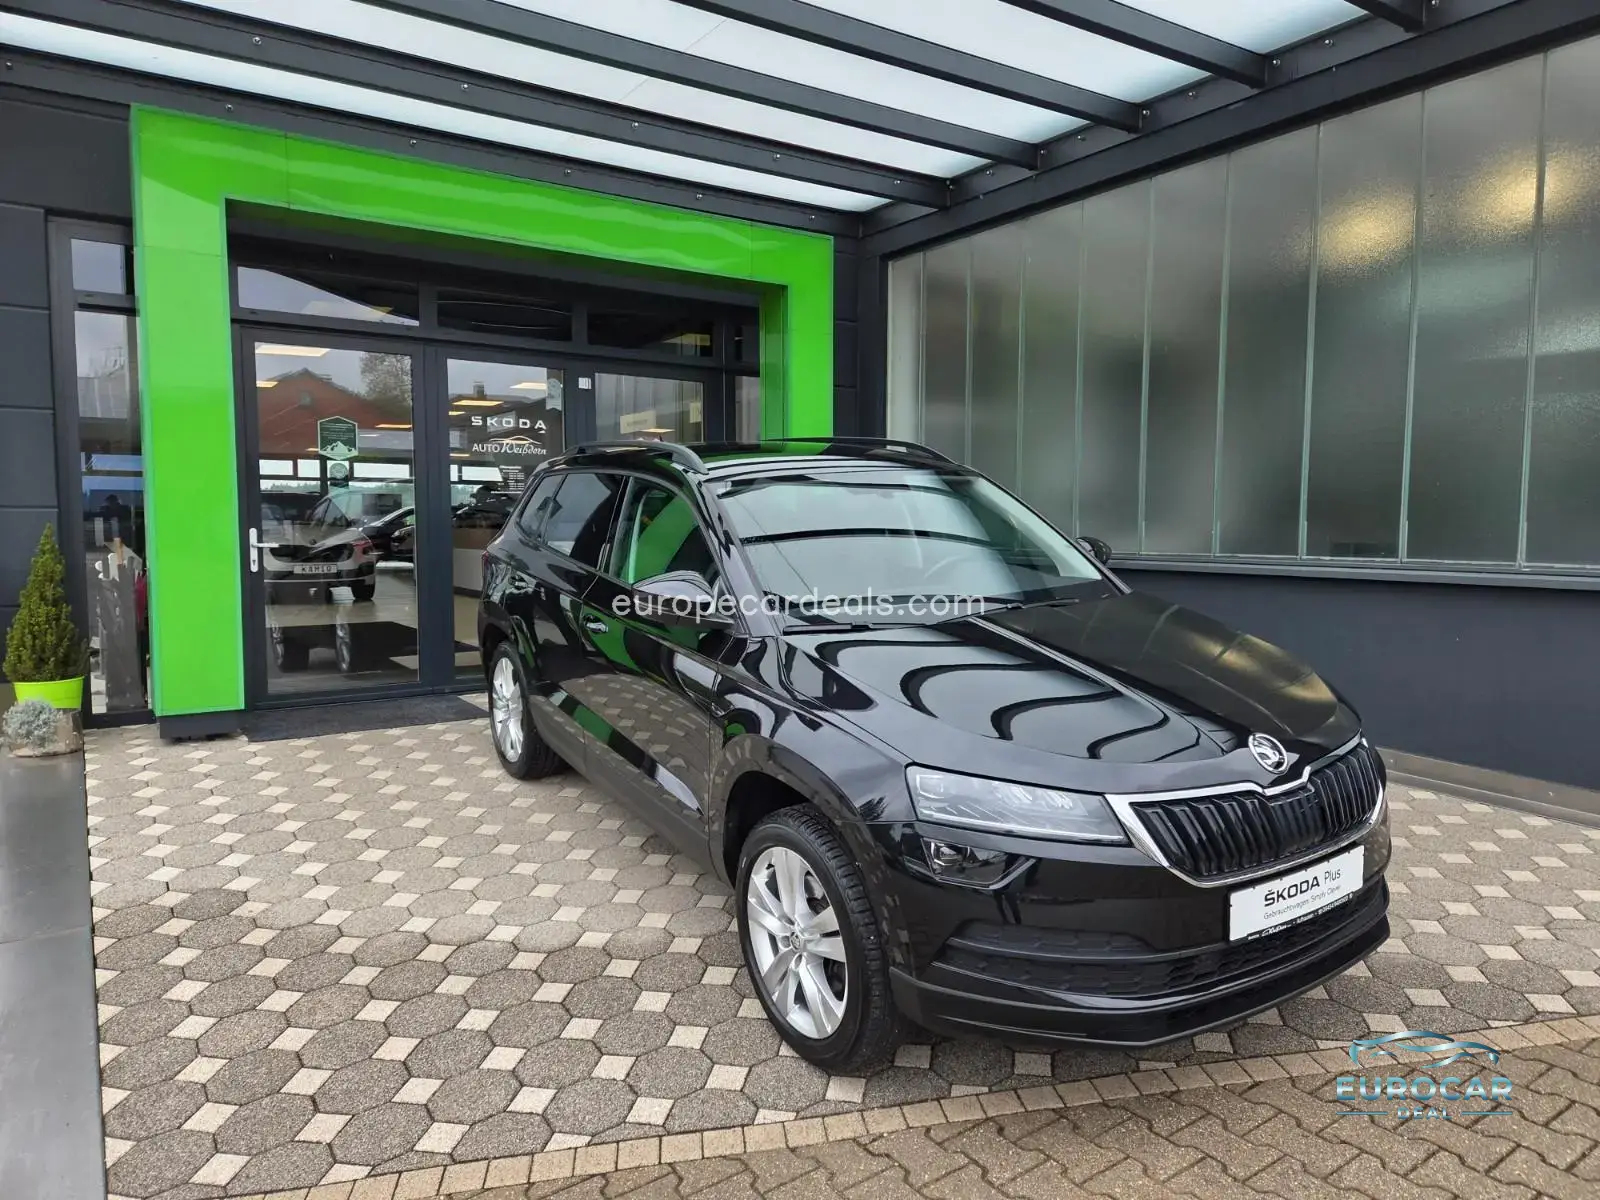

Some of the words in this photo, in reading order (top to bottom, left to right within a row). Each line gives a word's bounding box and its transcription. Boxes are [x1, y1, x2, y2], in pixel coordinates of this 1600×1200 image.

[472, 443, 500, 453] AUTO
[1264, 876, 1321, 907] ŠKODA
[1324, 869, 1341, 885] Plus
